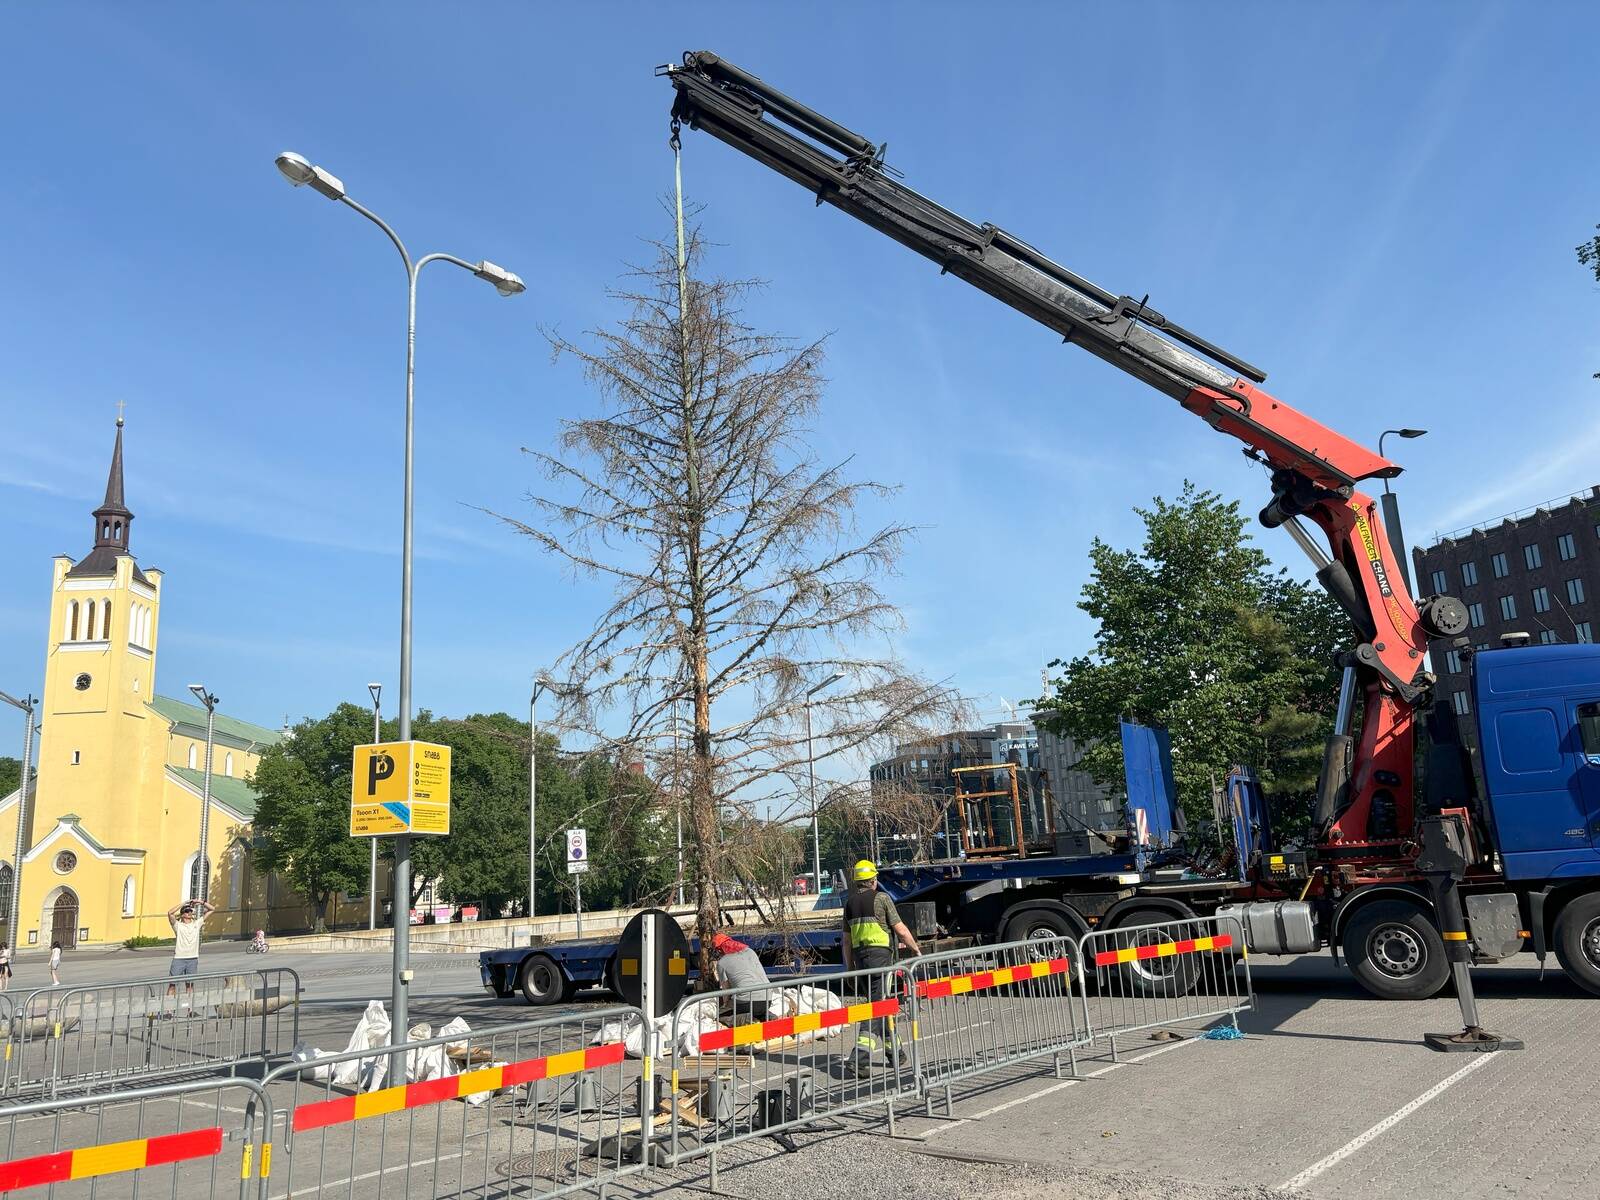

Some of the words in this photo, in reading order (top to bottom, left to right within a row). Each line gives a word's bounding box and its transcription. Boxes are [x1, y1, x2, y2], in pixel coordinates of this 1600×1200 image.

[1356, 514, 1377, 560] PALFINGER
[1372, 561, 1391, 594] CRANE
[367, 754, 395, 796] P
